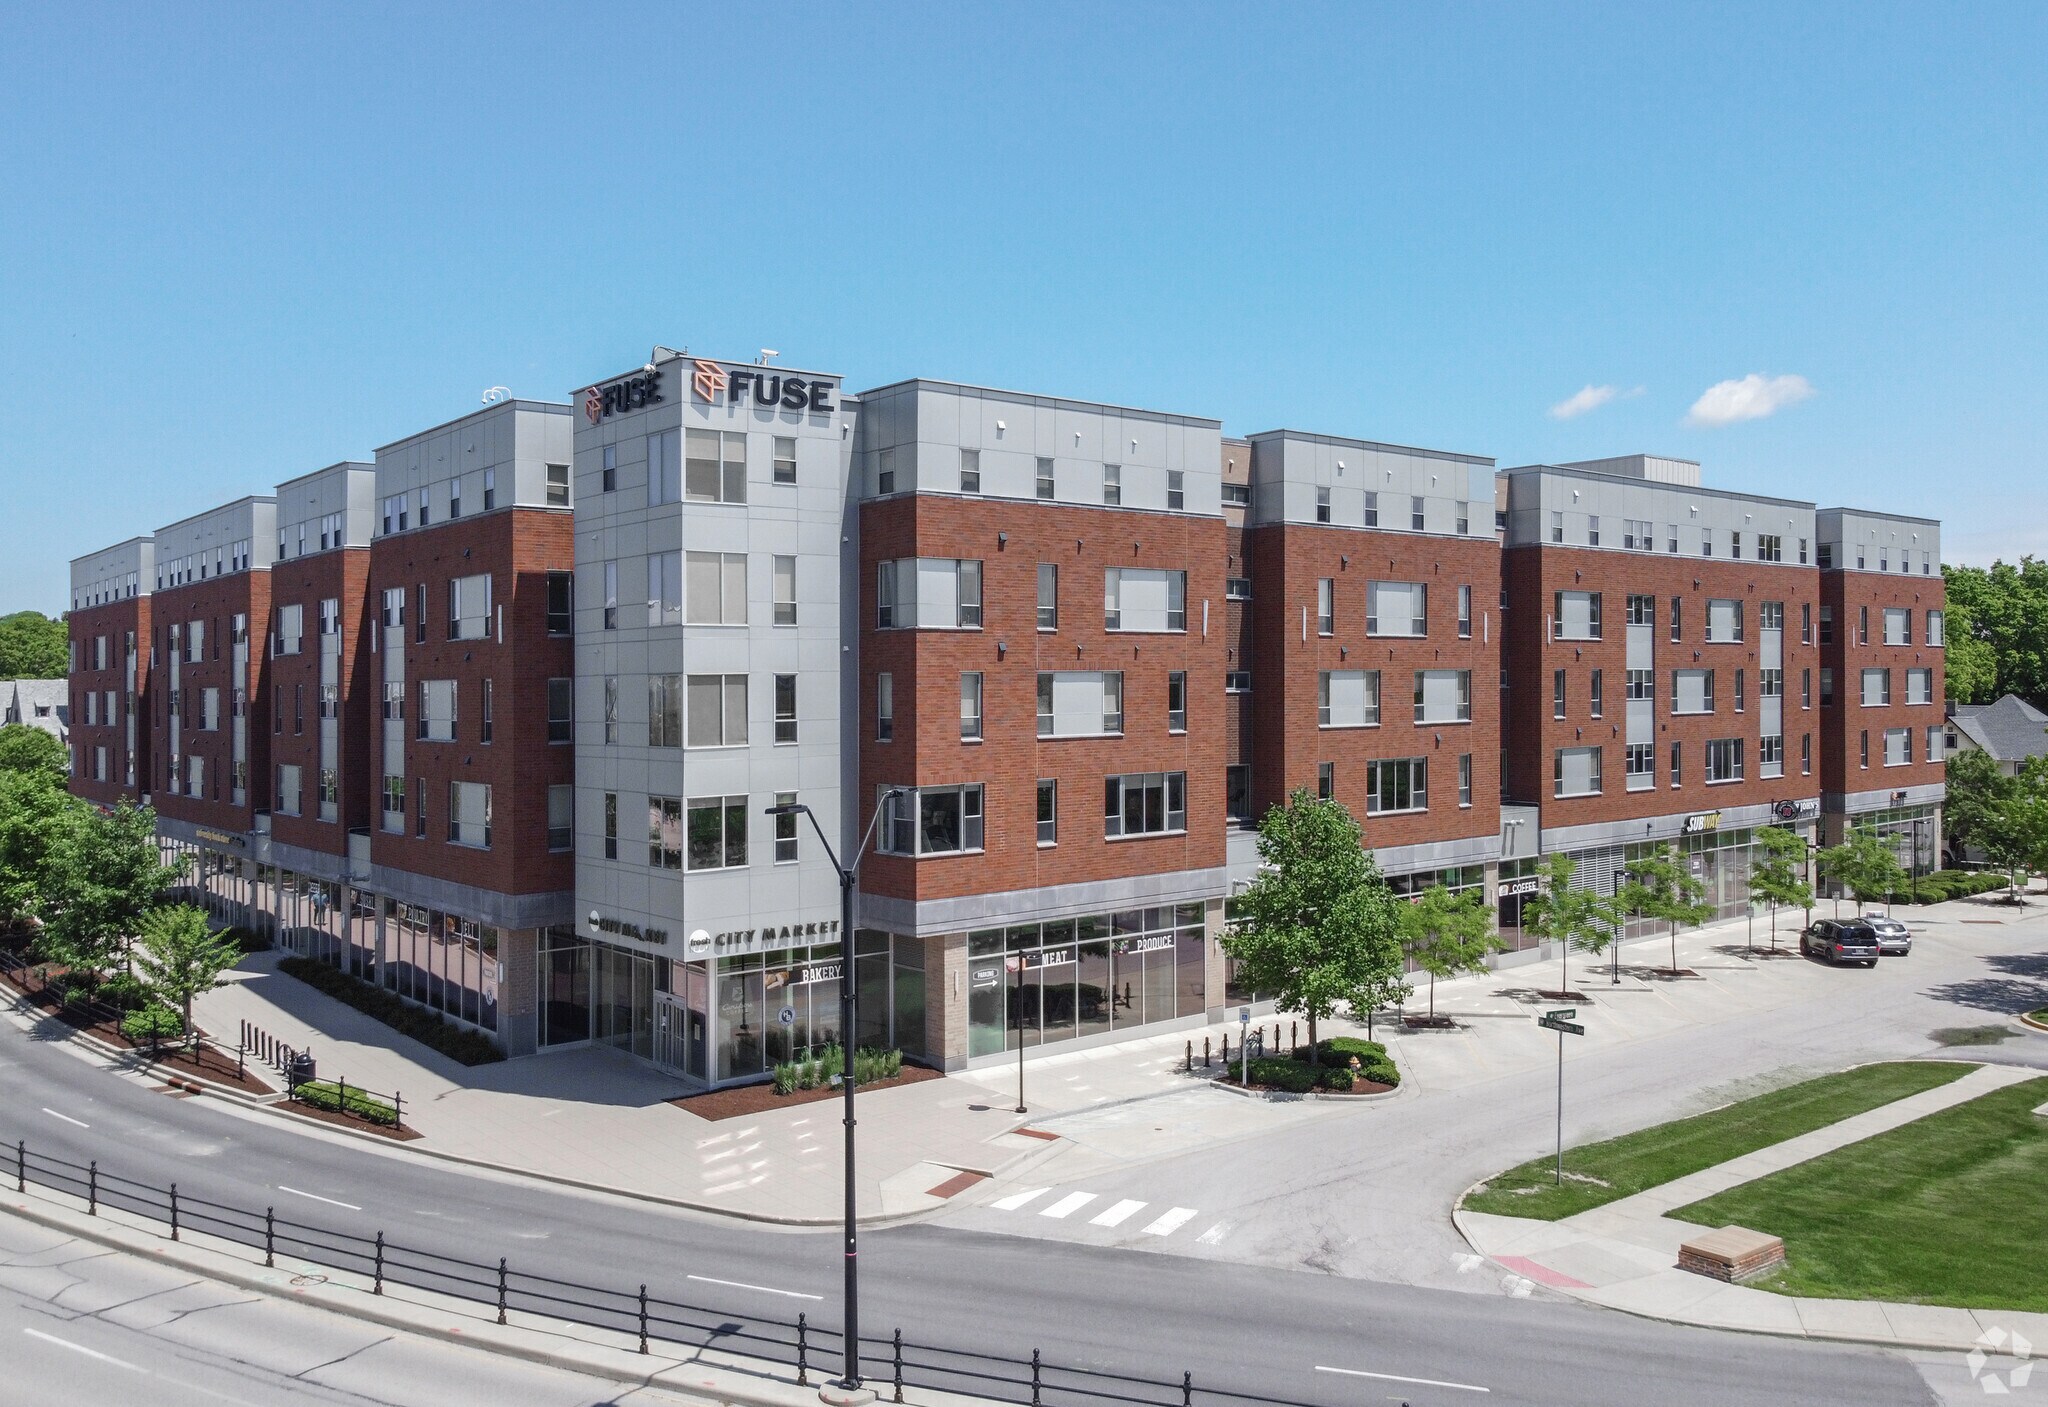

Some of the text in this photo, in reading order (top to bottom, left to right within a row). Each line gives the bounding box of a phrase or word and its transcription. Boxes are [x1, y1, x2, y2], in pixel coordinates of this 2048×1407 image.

[602, 371, 663, 417] FUSE
[730, 371, 834, 412] FUSE
[1687, 814, 1722, 832] SUBWAY
[1512, 881, 1536, 893] COFFEE
[689, 920, 839, 947] fresh CITY MARKET
[1137, 935, 1172, 951] PRODUCE
[1041, 950, 1068, 966] MEAT
[802, 965, 842, 983] BAKERY
